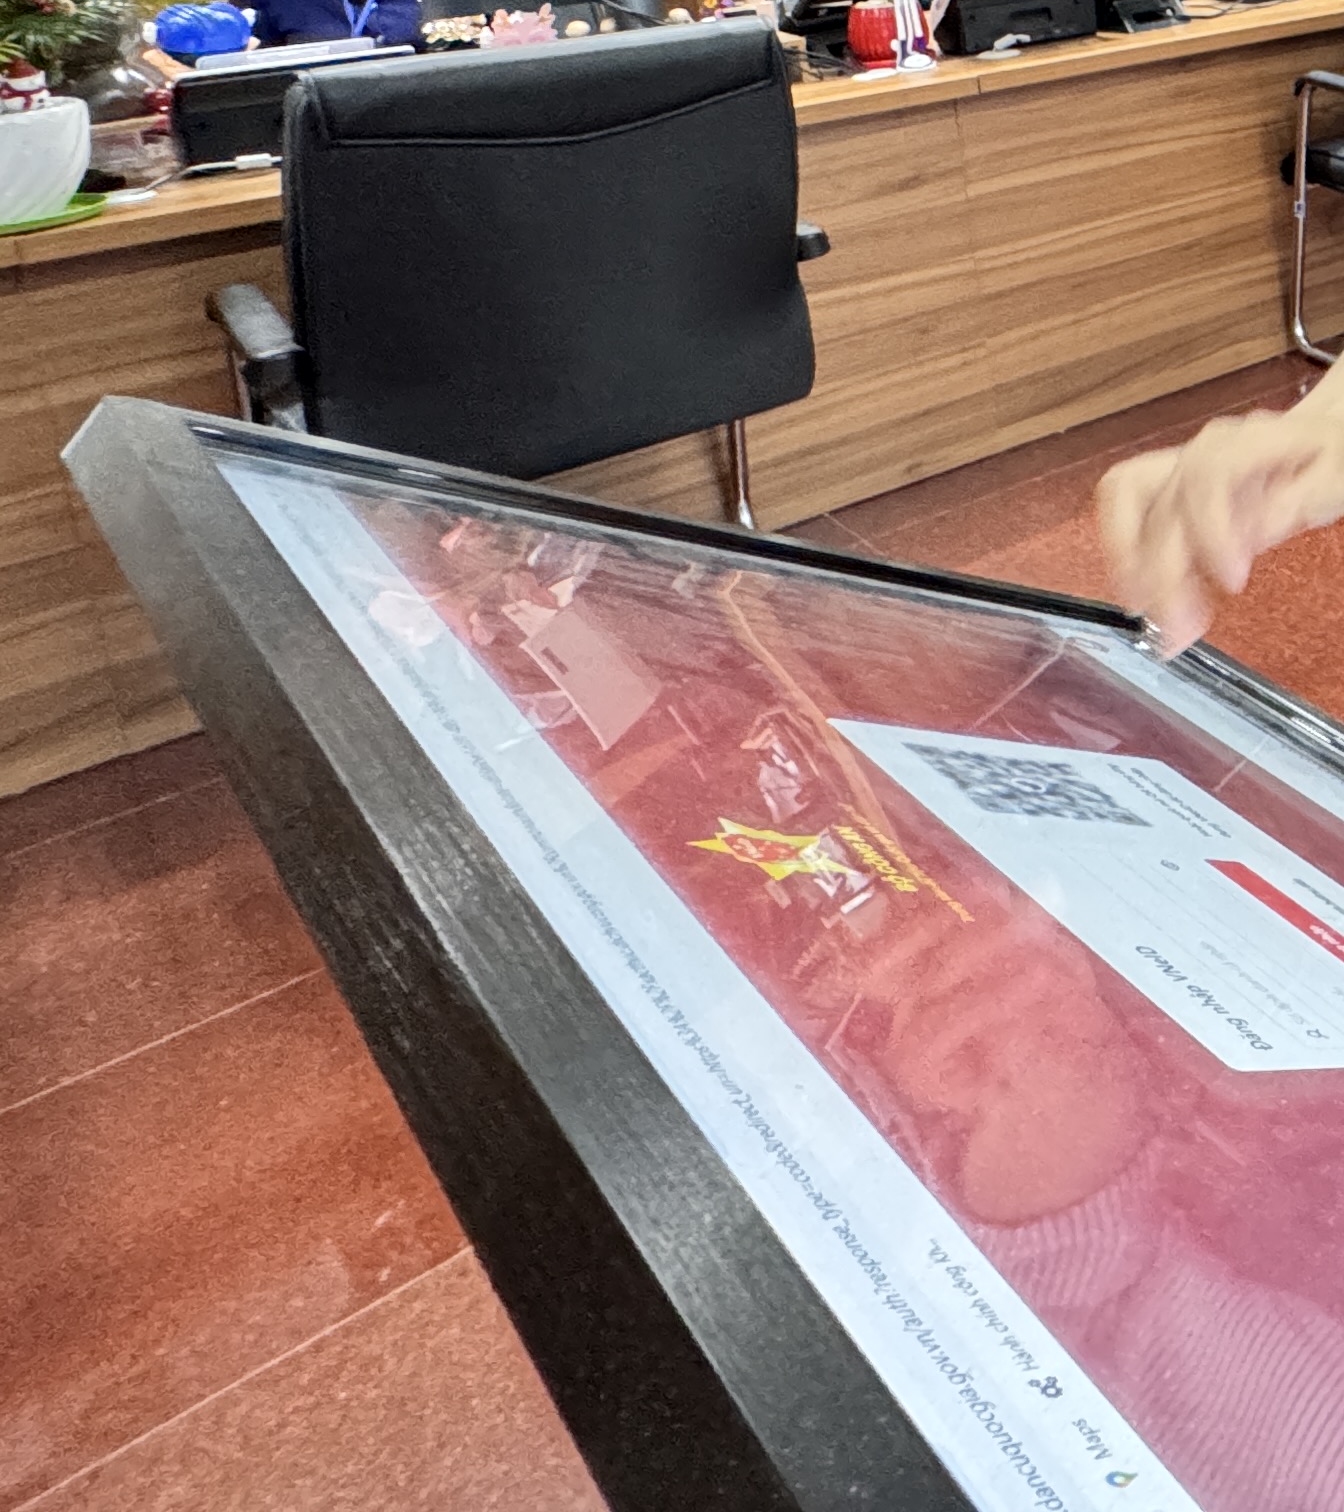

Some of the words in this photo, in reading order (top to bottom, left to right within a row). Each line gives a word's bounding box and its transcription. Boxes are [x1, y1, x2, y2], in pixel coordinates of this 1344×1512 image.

[1135, 946, 1189, 982] VNeID
[1186, 980, 1230, 1014] nhập
[1227, 1018, 1274, 1051] Đăng
[1071, 1418, 1113, 1460] Maps
